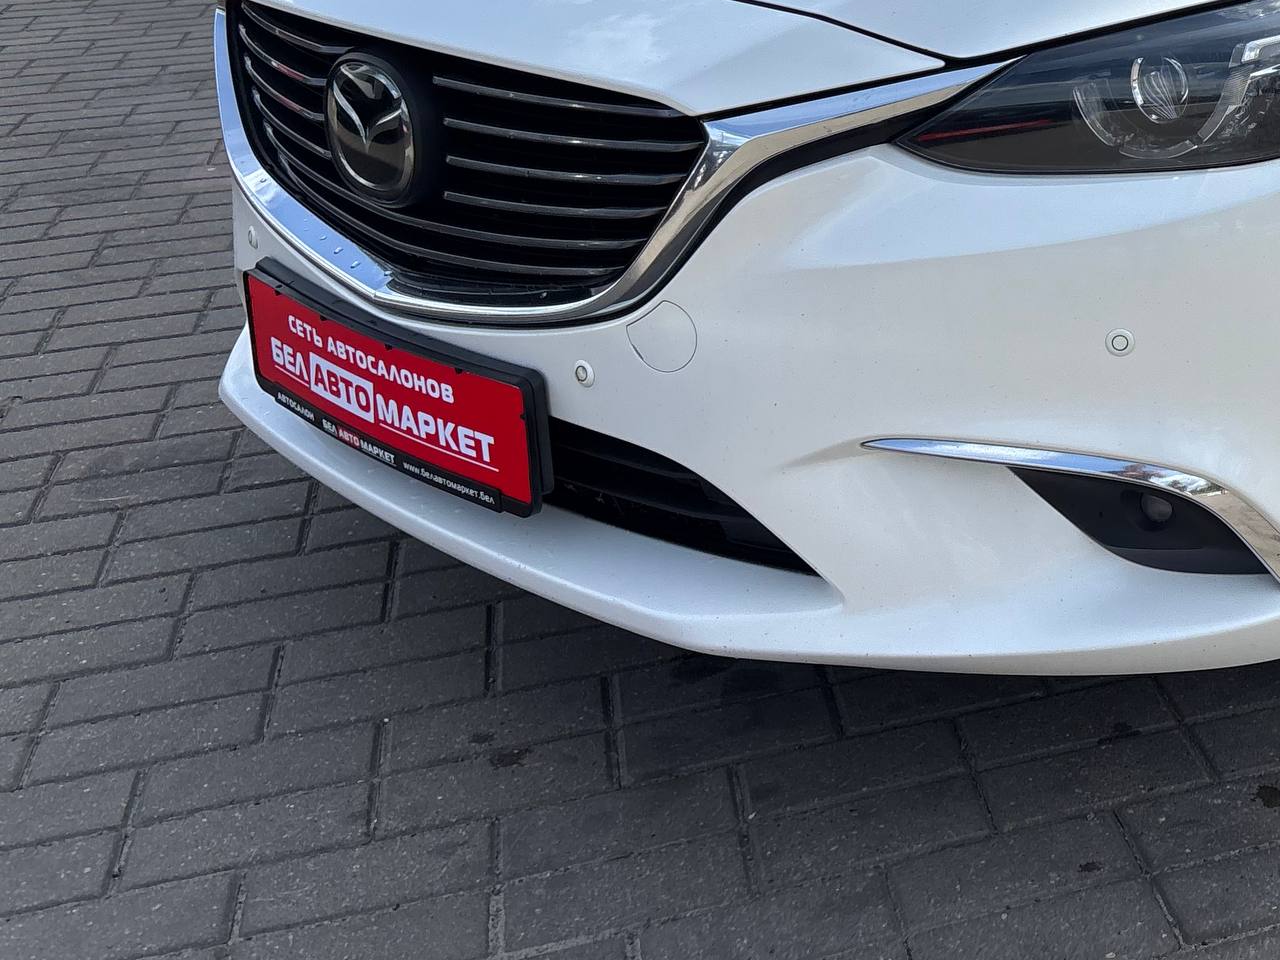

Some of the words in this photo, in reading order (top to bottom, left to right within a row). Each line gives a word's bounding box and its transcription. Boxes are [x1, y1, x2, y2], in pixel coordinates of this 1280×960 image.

[270, 336, 309, 382] БЕЛ
[313, 361, 373, 411] АВТО
[376, 394, 495, 463] МАРКЕТ
[288, 315, 323, 348] СЕТЬ
[327, 336, 455, 404] АВТОСАЛОНОВ
[277, 392, 315, 422] АВТОСАЛОН
